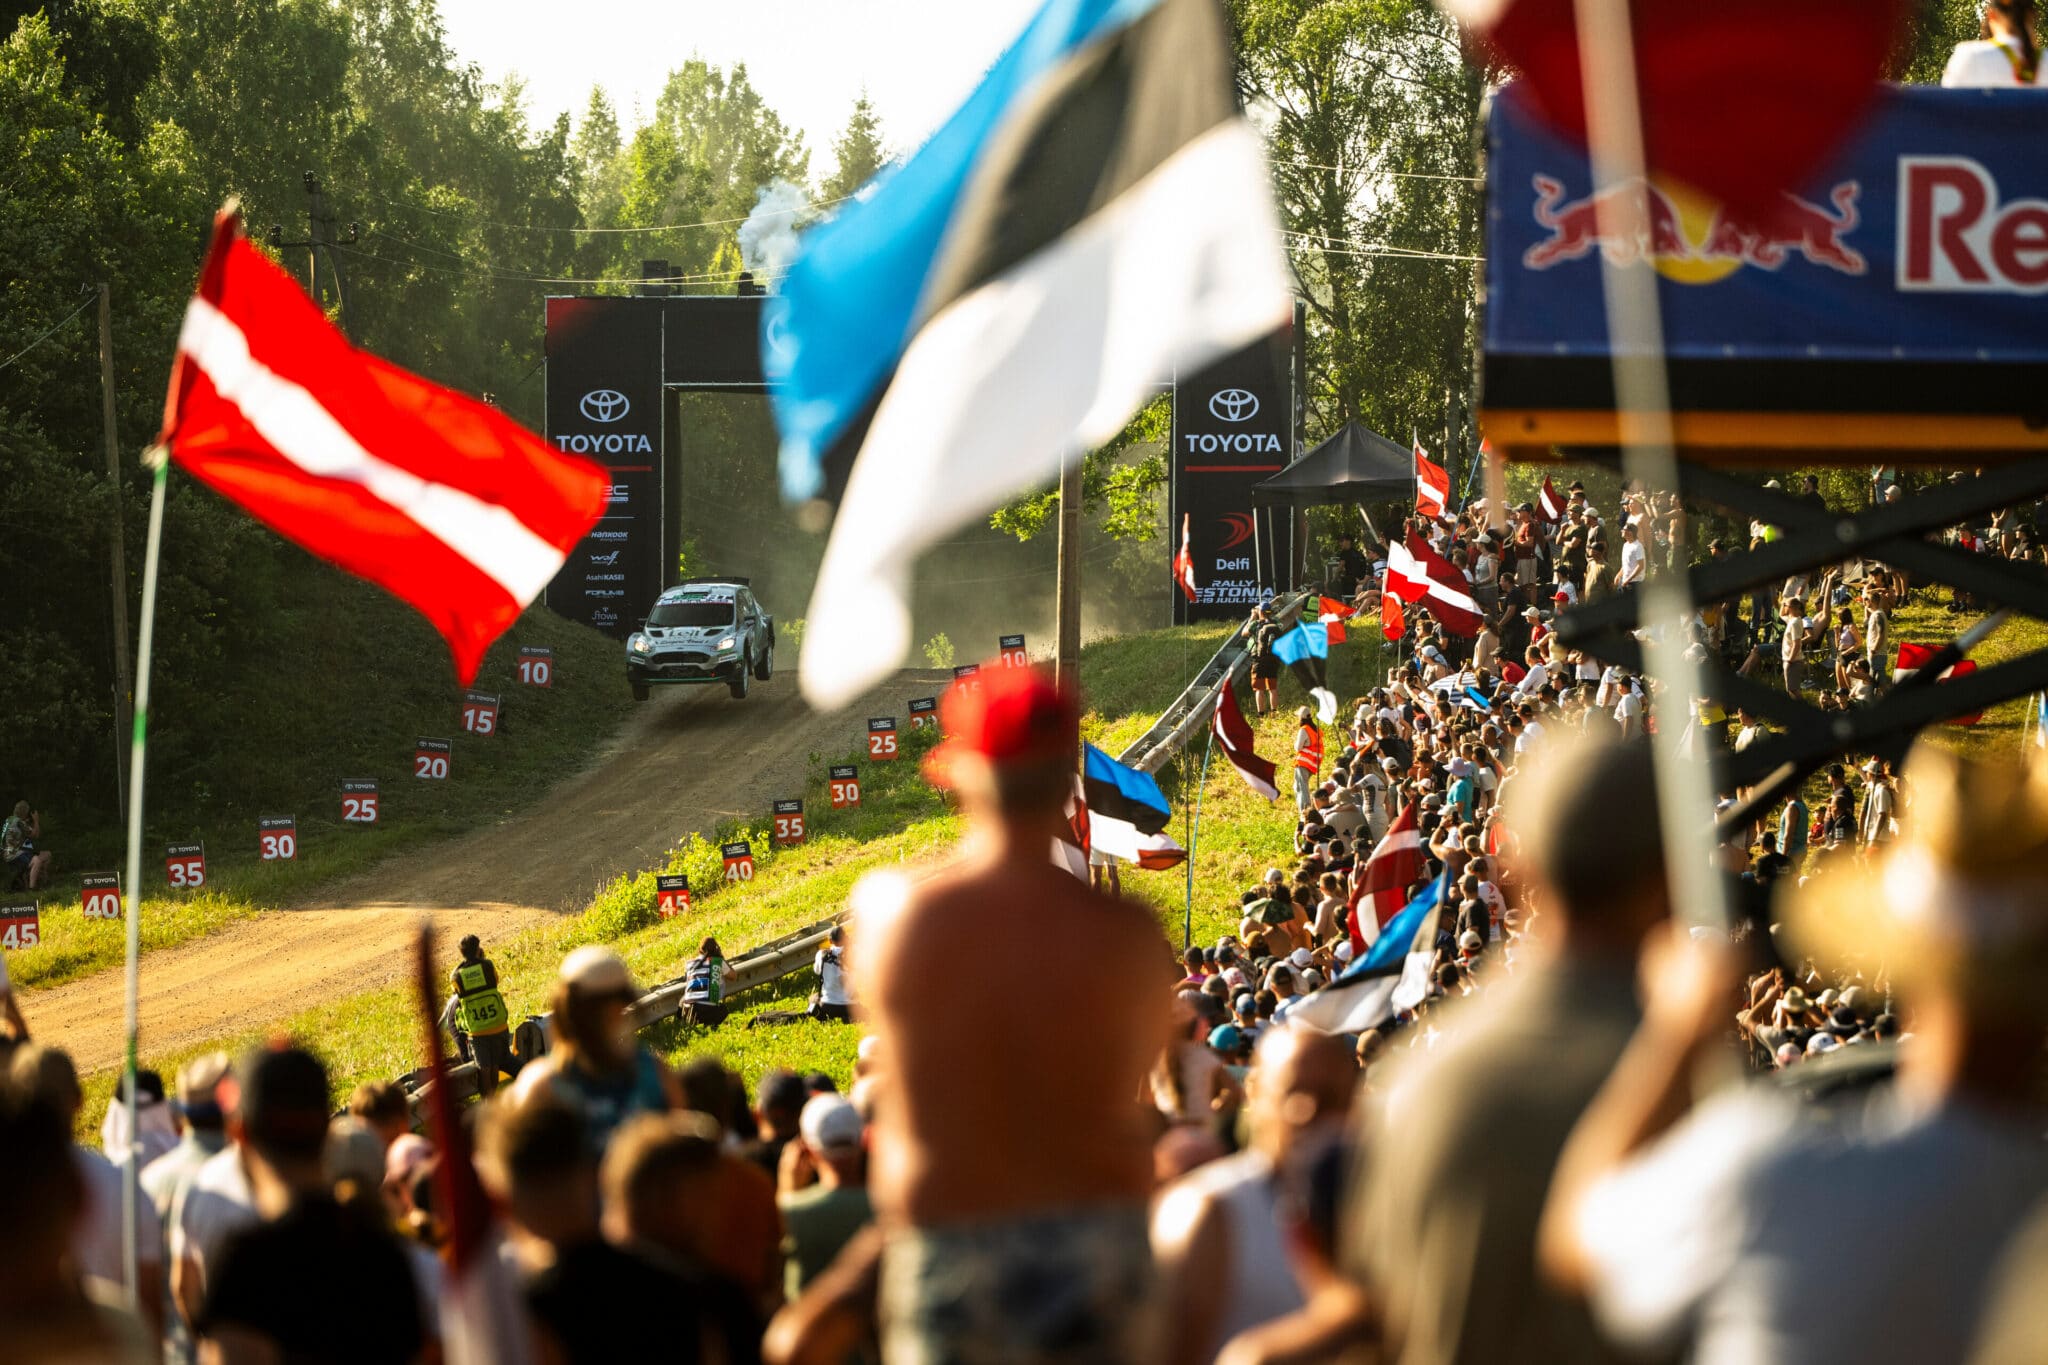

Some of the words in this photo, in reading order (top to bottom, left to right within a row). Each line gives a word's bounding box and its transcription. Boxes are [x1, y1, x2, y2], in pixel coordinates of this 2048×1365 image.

[556, 434, 653, 453] TOYOTA
[1185, 434, 1282, 453] TOYOTA
[602, 485, 629, 496] RC
[1216, 557, 1250, 570] Delfi
[1194, 587, 1275, 597] ESTONIA
[1003, 651, 1025, 668] 10
[520, 661, 549, 684] 10
[476, 695, 496, 703] TOYOTA
[464, 708, 493, 733] 15
[870, 735, 896, 754] 25
[415, 756, 448, 779] 20
[832, 783, 859, 803] 30
[344, 799, 377, 822] 25
[776, 818, 803, 838] 35
[178, 845, 200, 853] TOYOTA
[262, 835, 295, 860] 30
[169, 862, 204, 888] 35
[726, 861, 753, 881] 40
[84, 894, 120, 919] 40
[660, 895, 689, 915] 45
[1, 923, 38, 950] 45
[472, 1004, 497, 1021] 145
